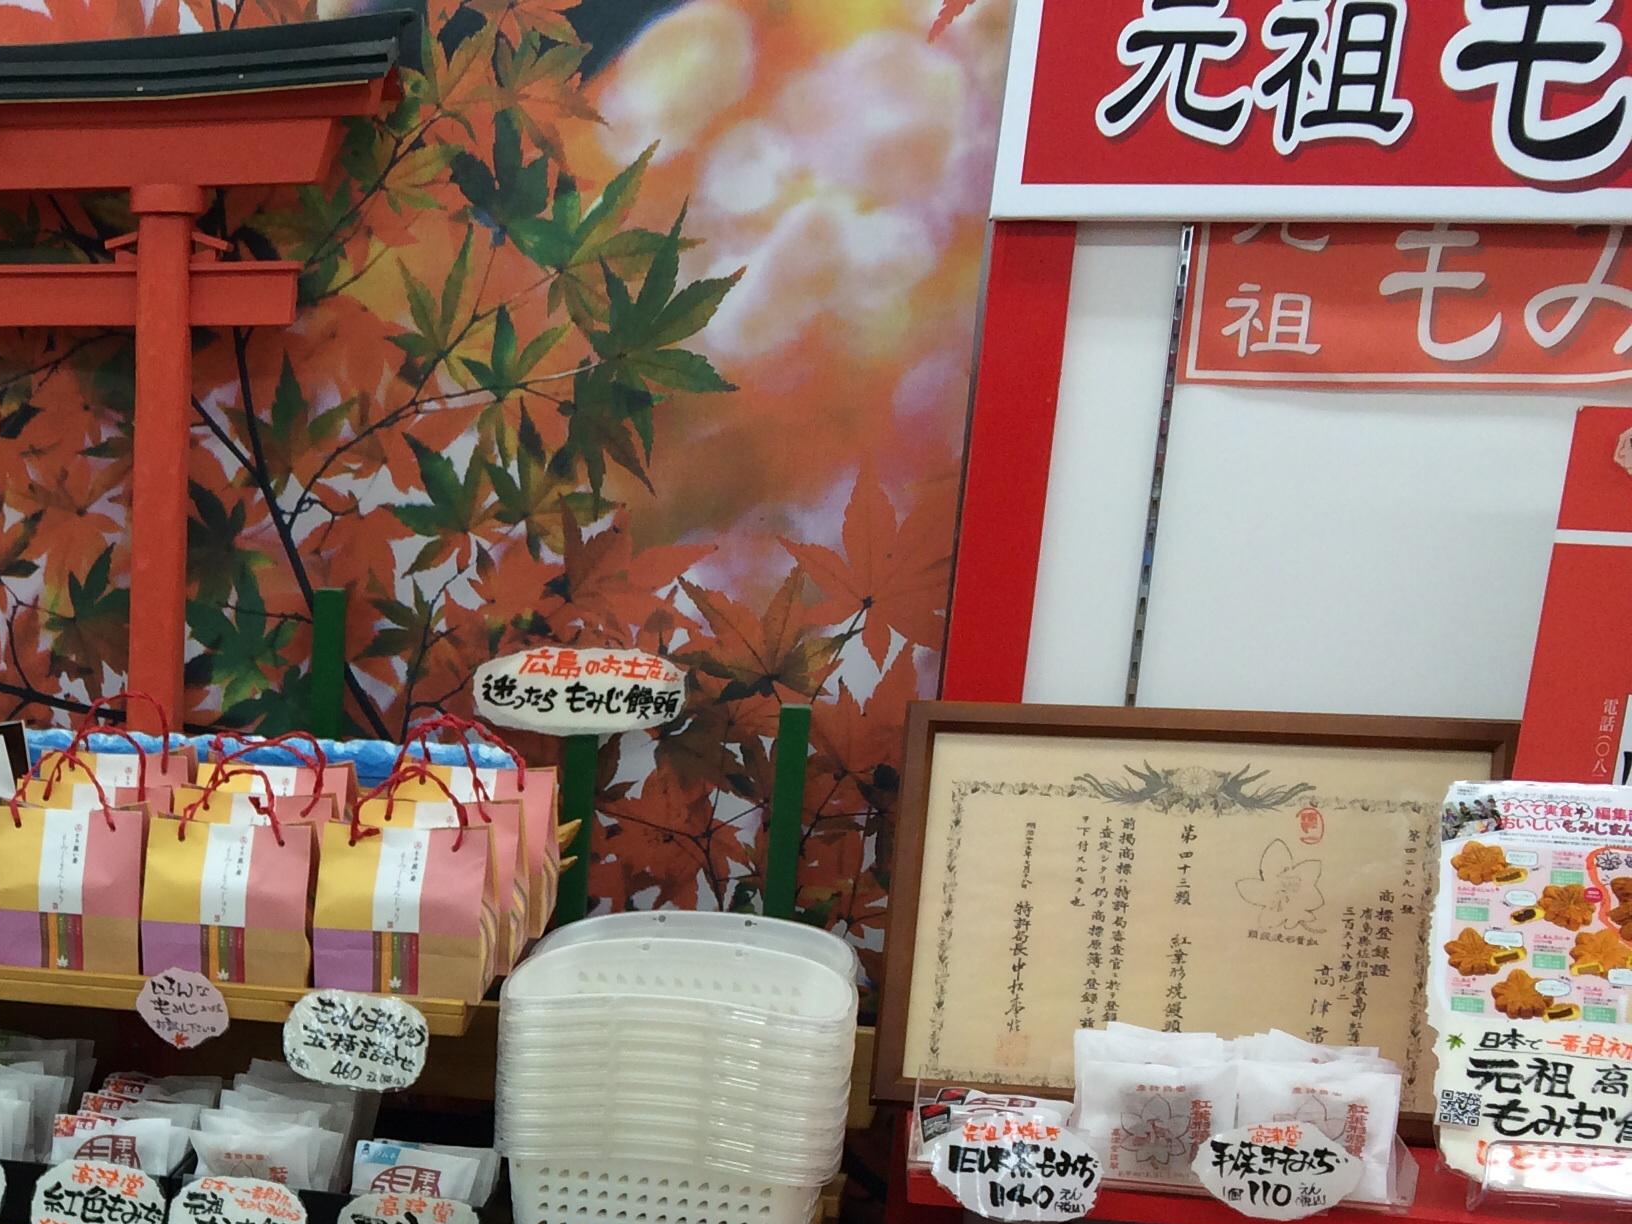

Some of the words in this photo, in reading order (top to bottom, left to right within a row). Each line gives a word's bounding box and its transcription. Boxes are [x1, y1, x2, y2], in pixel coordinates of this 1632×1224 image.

[150, 976, 209, 998] いろんな
[1479, 1028, 1543, 1050] 日本で
[330, 1060, 361, 1081] 460
[1467, 1057, 1576, 1099] 元祖
[183, 1191, 224, 1216] 元祖
[1248, 1179, 1292, 1208] 110
